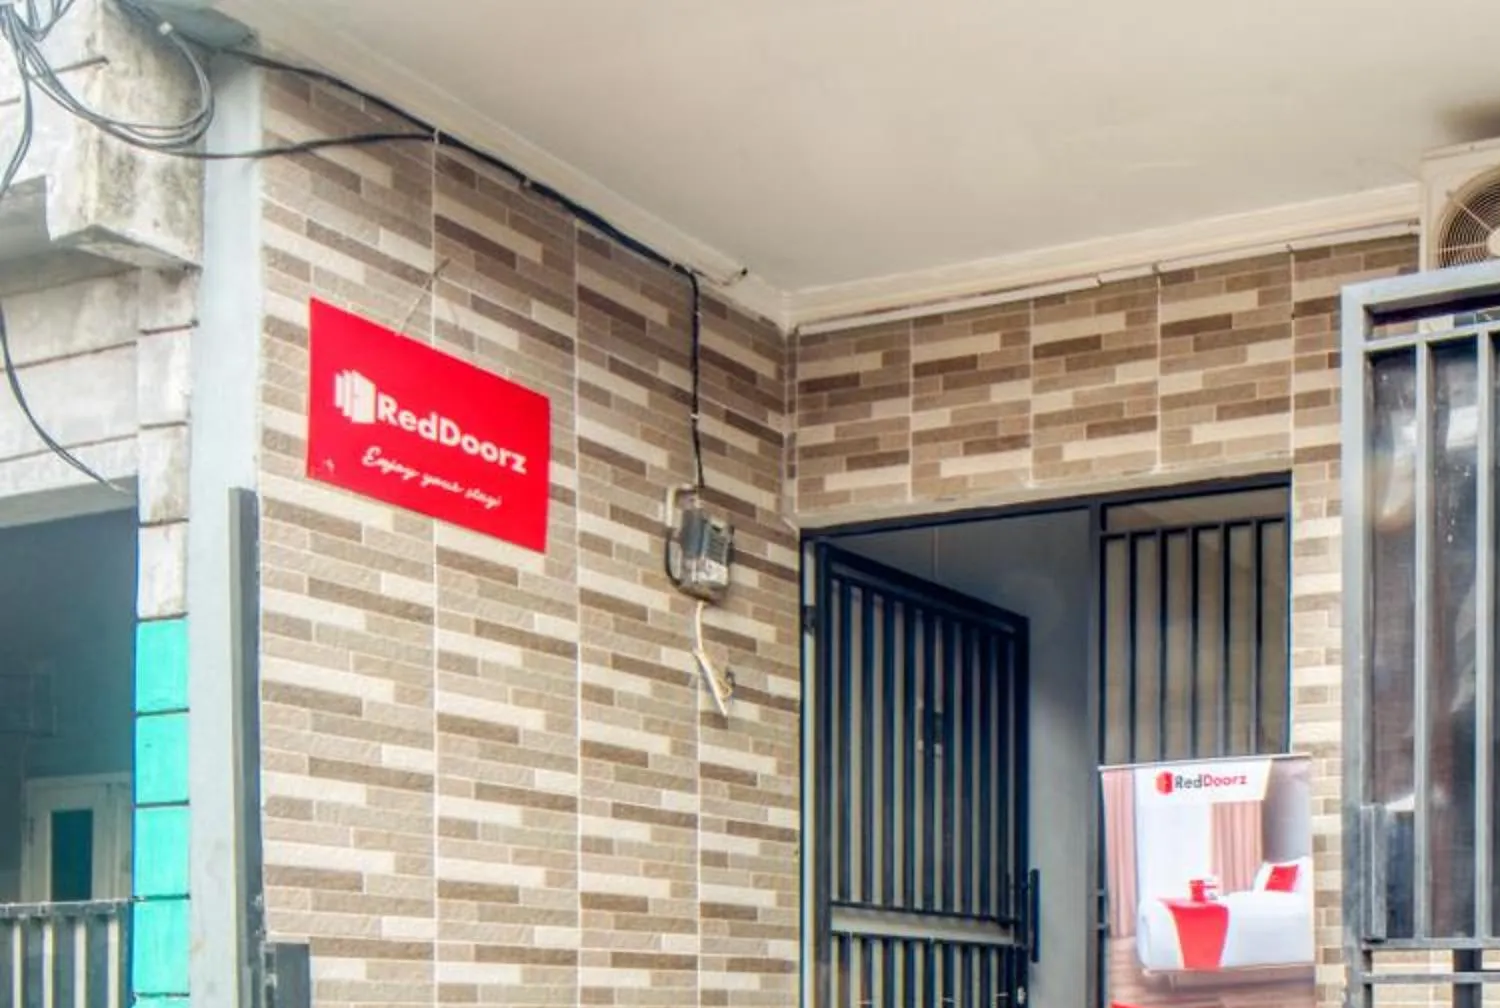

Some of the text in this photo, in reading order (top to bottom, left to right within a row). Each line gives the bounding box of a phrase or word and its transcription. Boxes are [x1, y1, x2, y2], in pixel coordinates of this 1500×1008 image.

[376, 391, 527, 475] RedDoorz
[361, 445, 420, 480] Enjoy
[420, 472, 464, 493] your
[1174, 773, 1247, 789] RedDoorz
